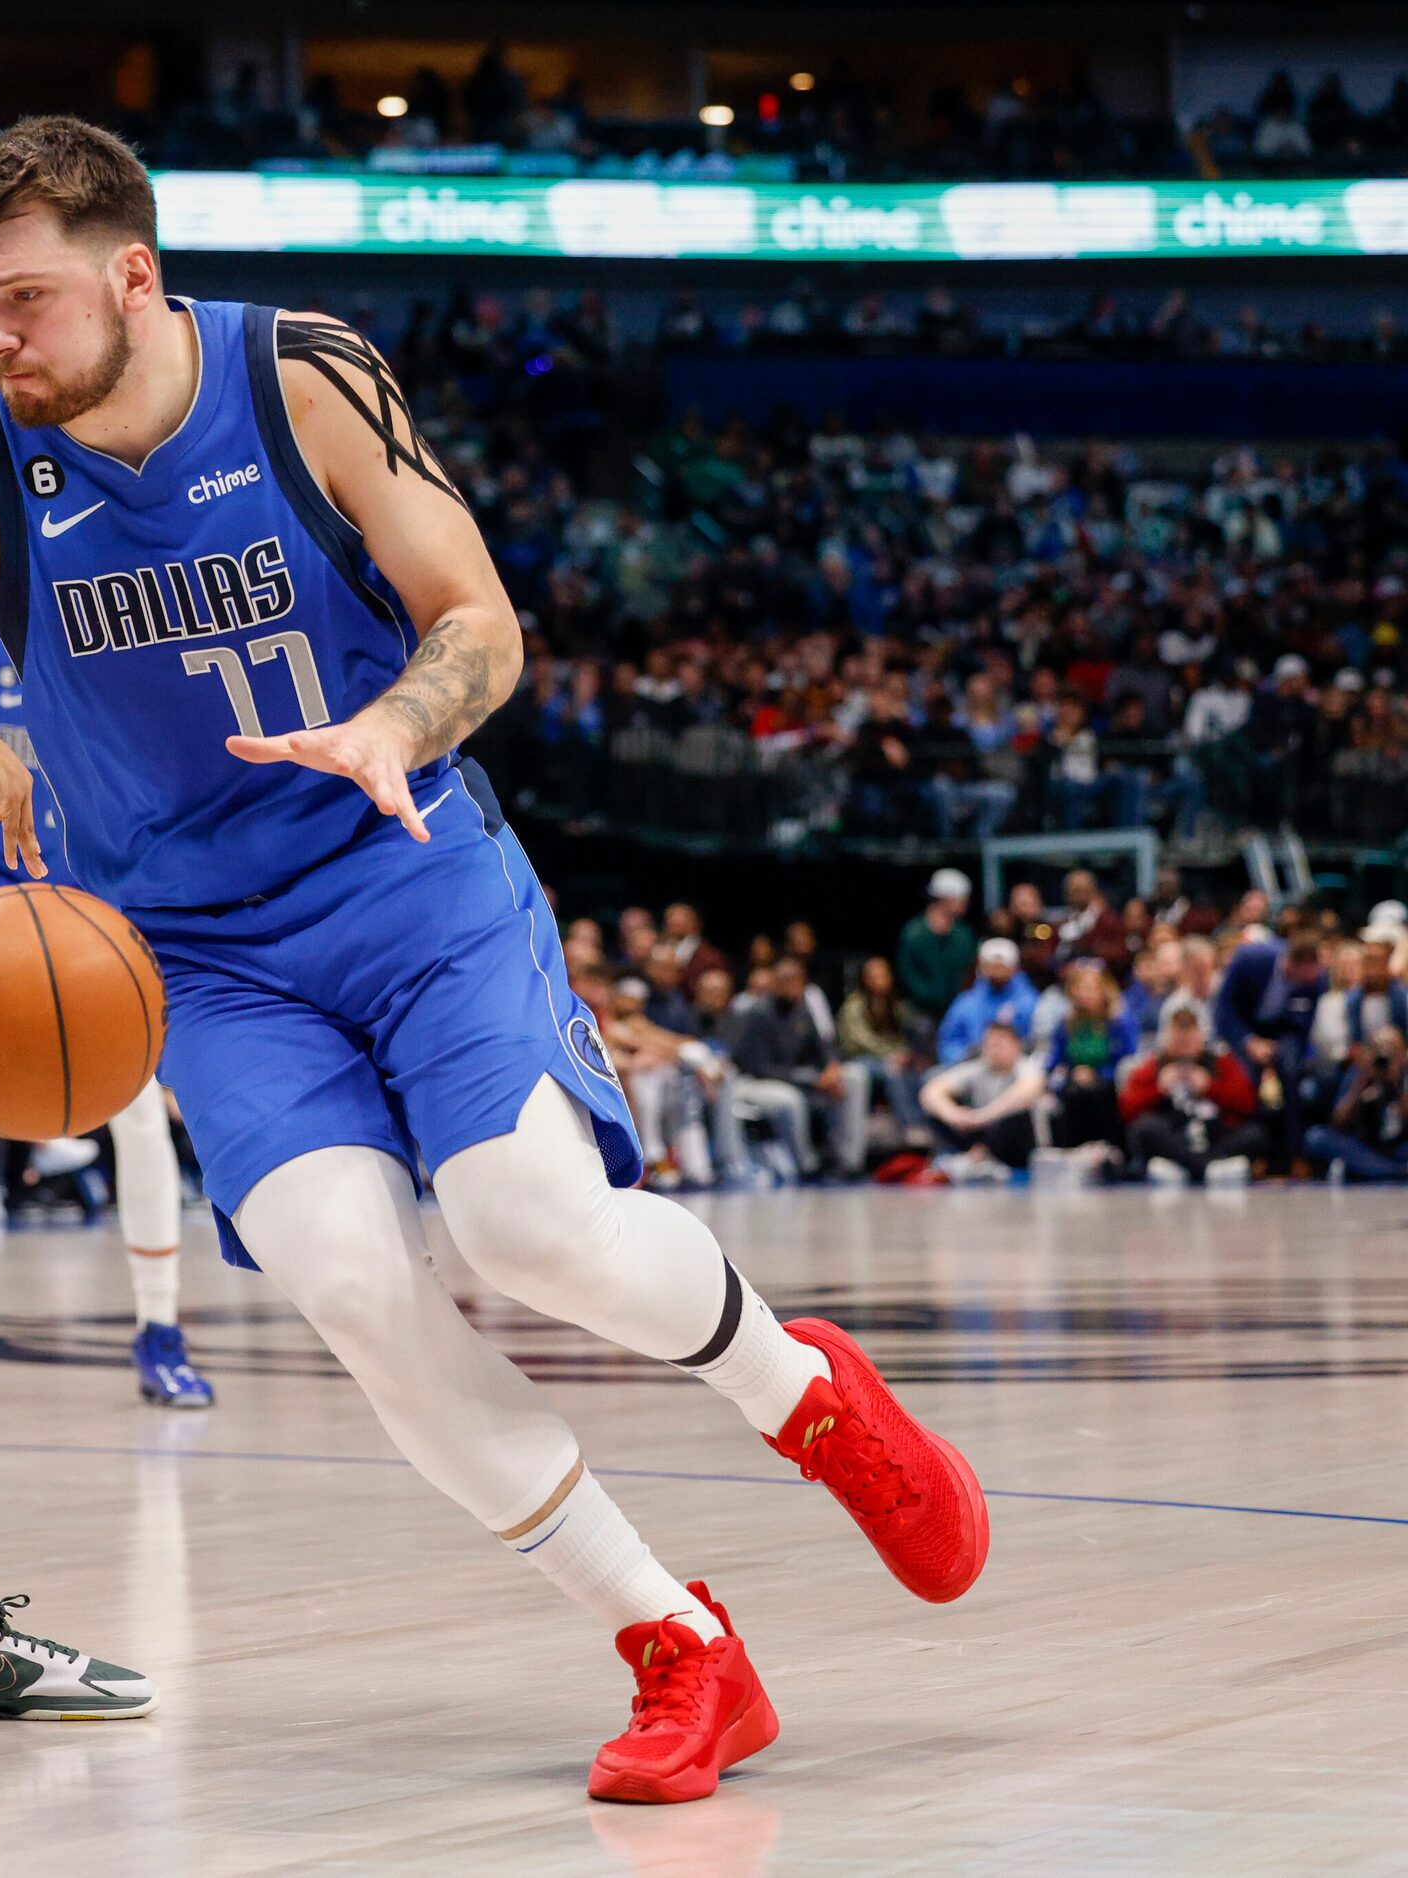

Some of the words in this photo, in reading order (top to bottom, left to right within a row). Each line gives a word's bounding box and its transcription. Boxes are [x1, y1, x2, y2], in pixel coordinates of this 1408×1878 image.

[772, 195, 920, 250] chime
[1173, 191, 1324, 247] chime
[31, 461, 57, 494] 6
[188, 460, 261, 505] chime
[53, 536, 295, 657] DALLAS
[180, 630, 332, 738] 77
